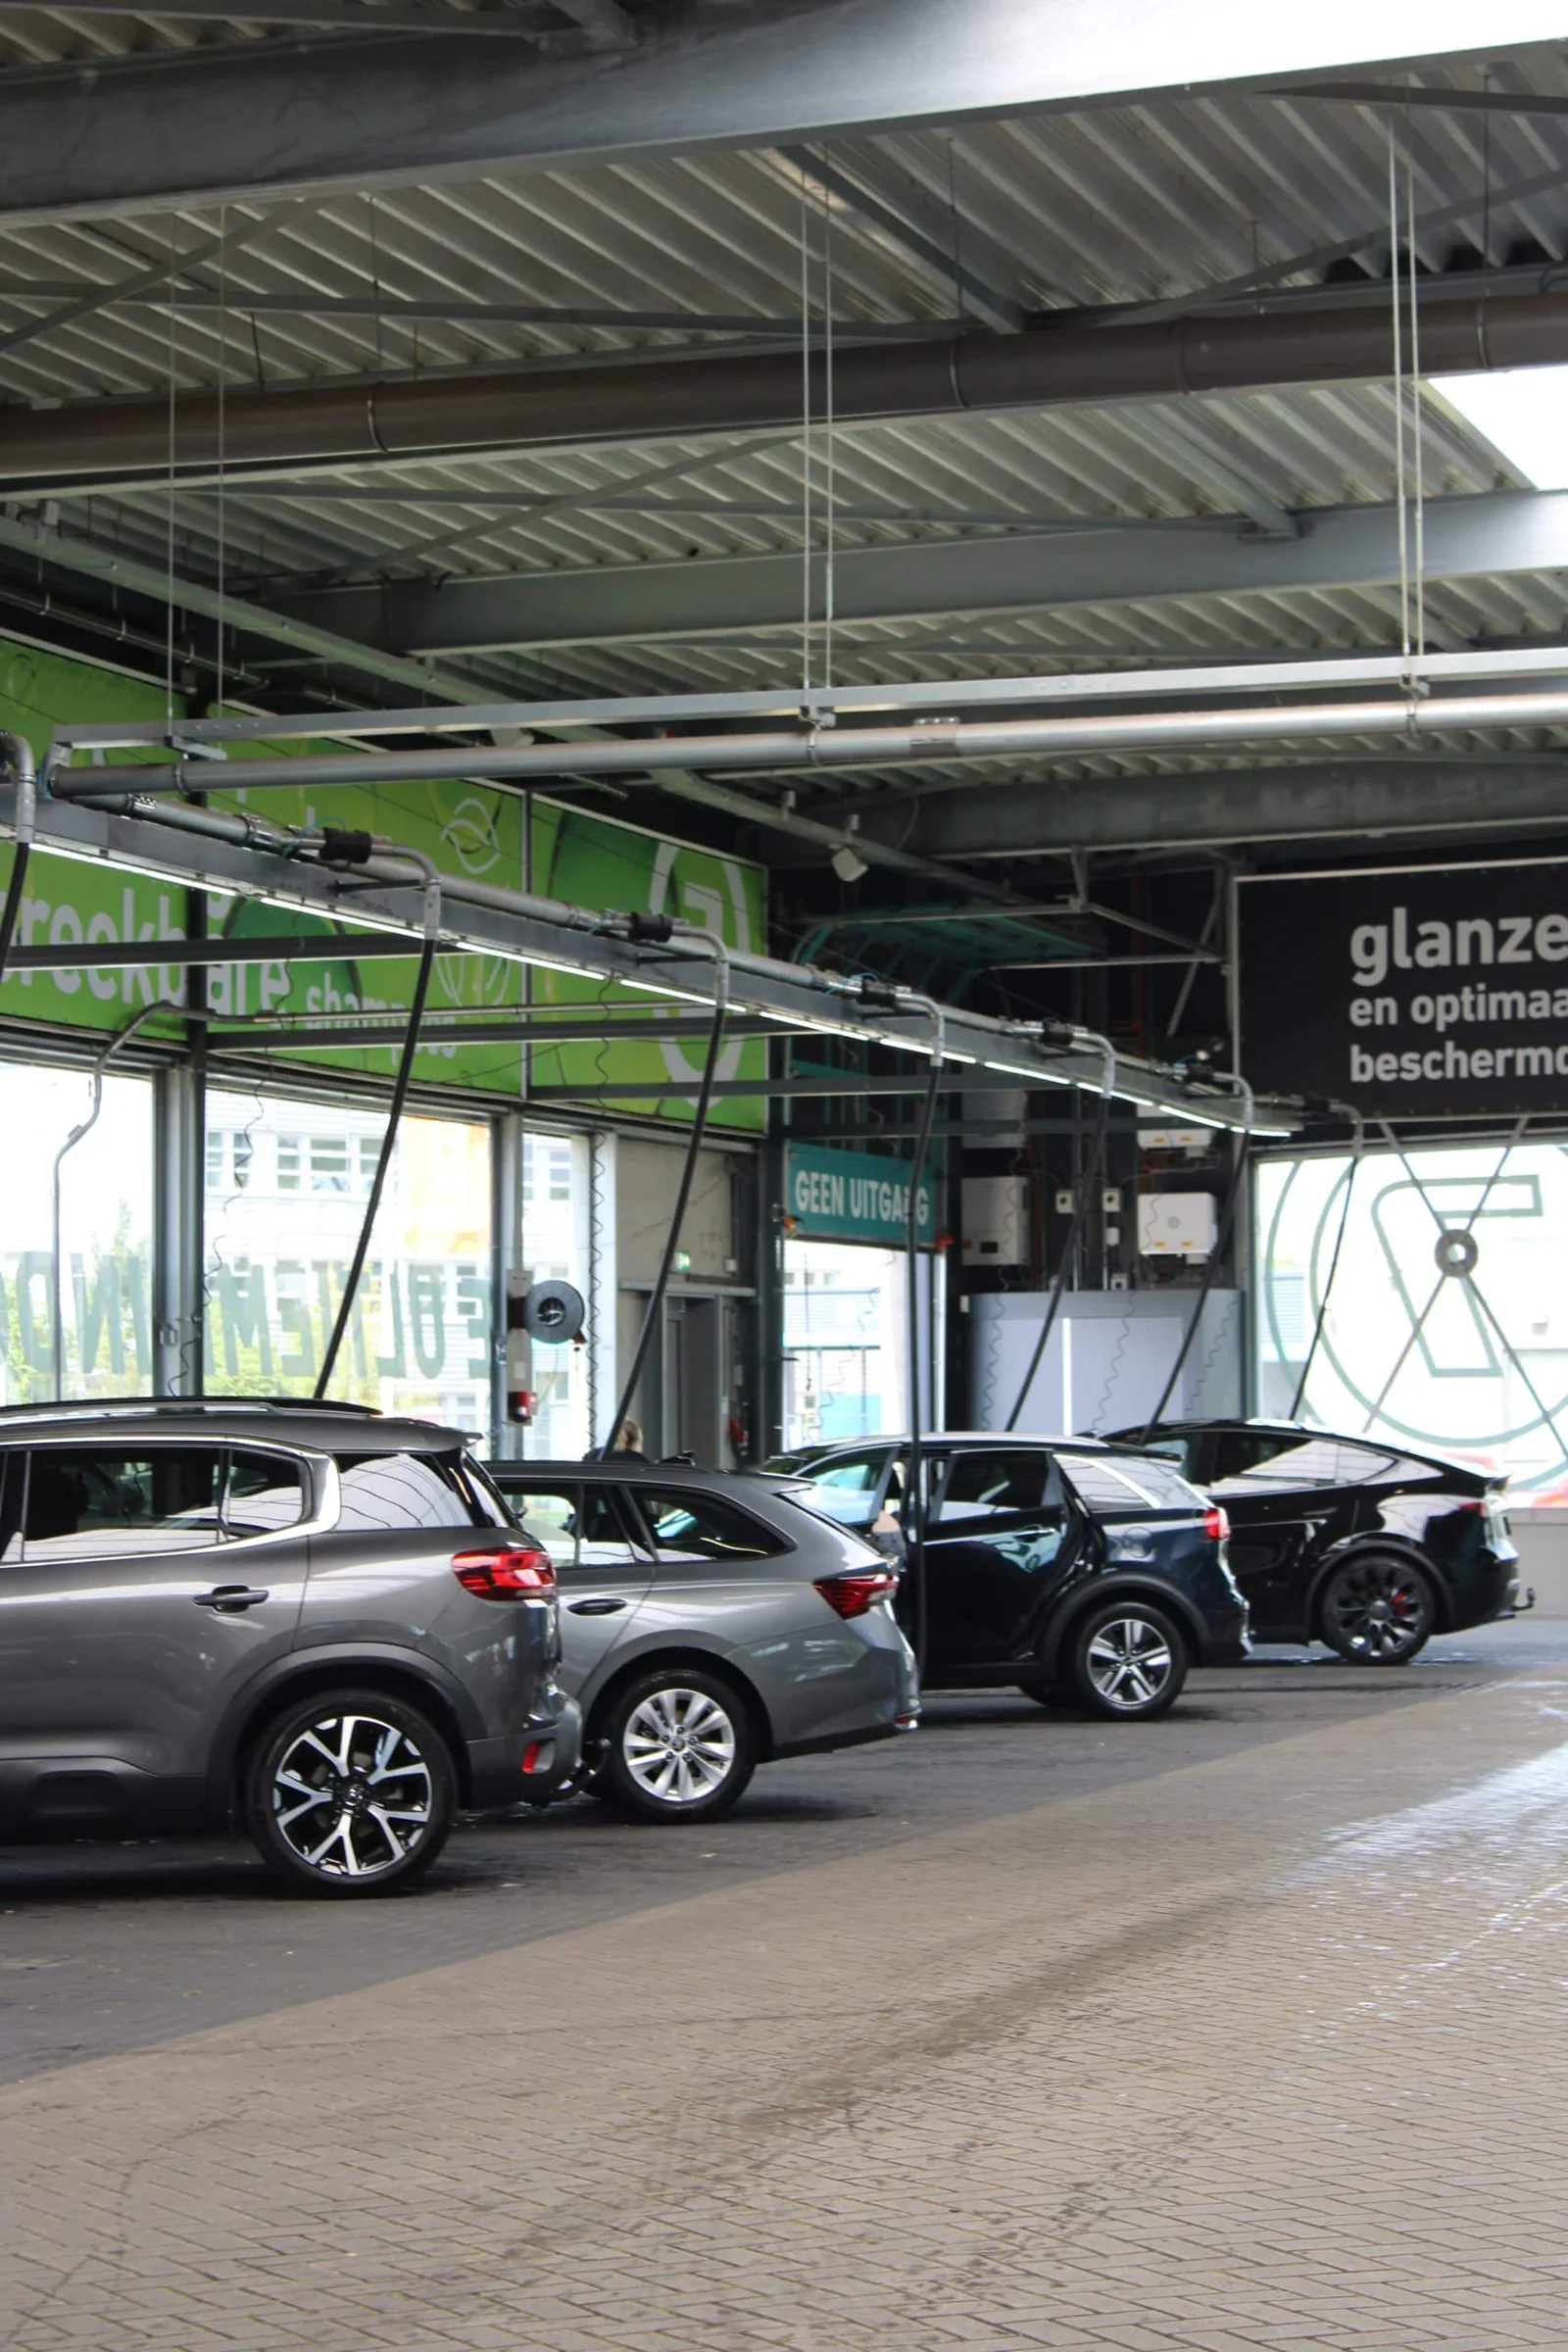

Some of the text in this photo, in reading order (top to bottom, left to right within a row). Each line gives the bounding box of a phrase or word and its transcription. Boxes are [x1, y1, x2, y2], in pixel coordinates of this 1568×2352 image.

[1349, 906, 1568, 987] glanze
[1349, 996, 1398, 1027] en
[795, 1170, 844, 1216] GEEN
